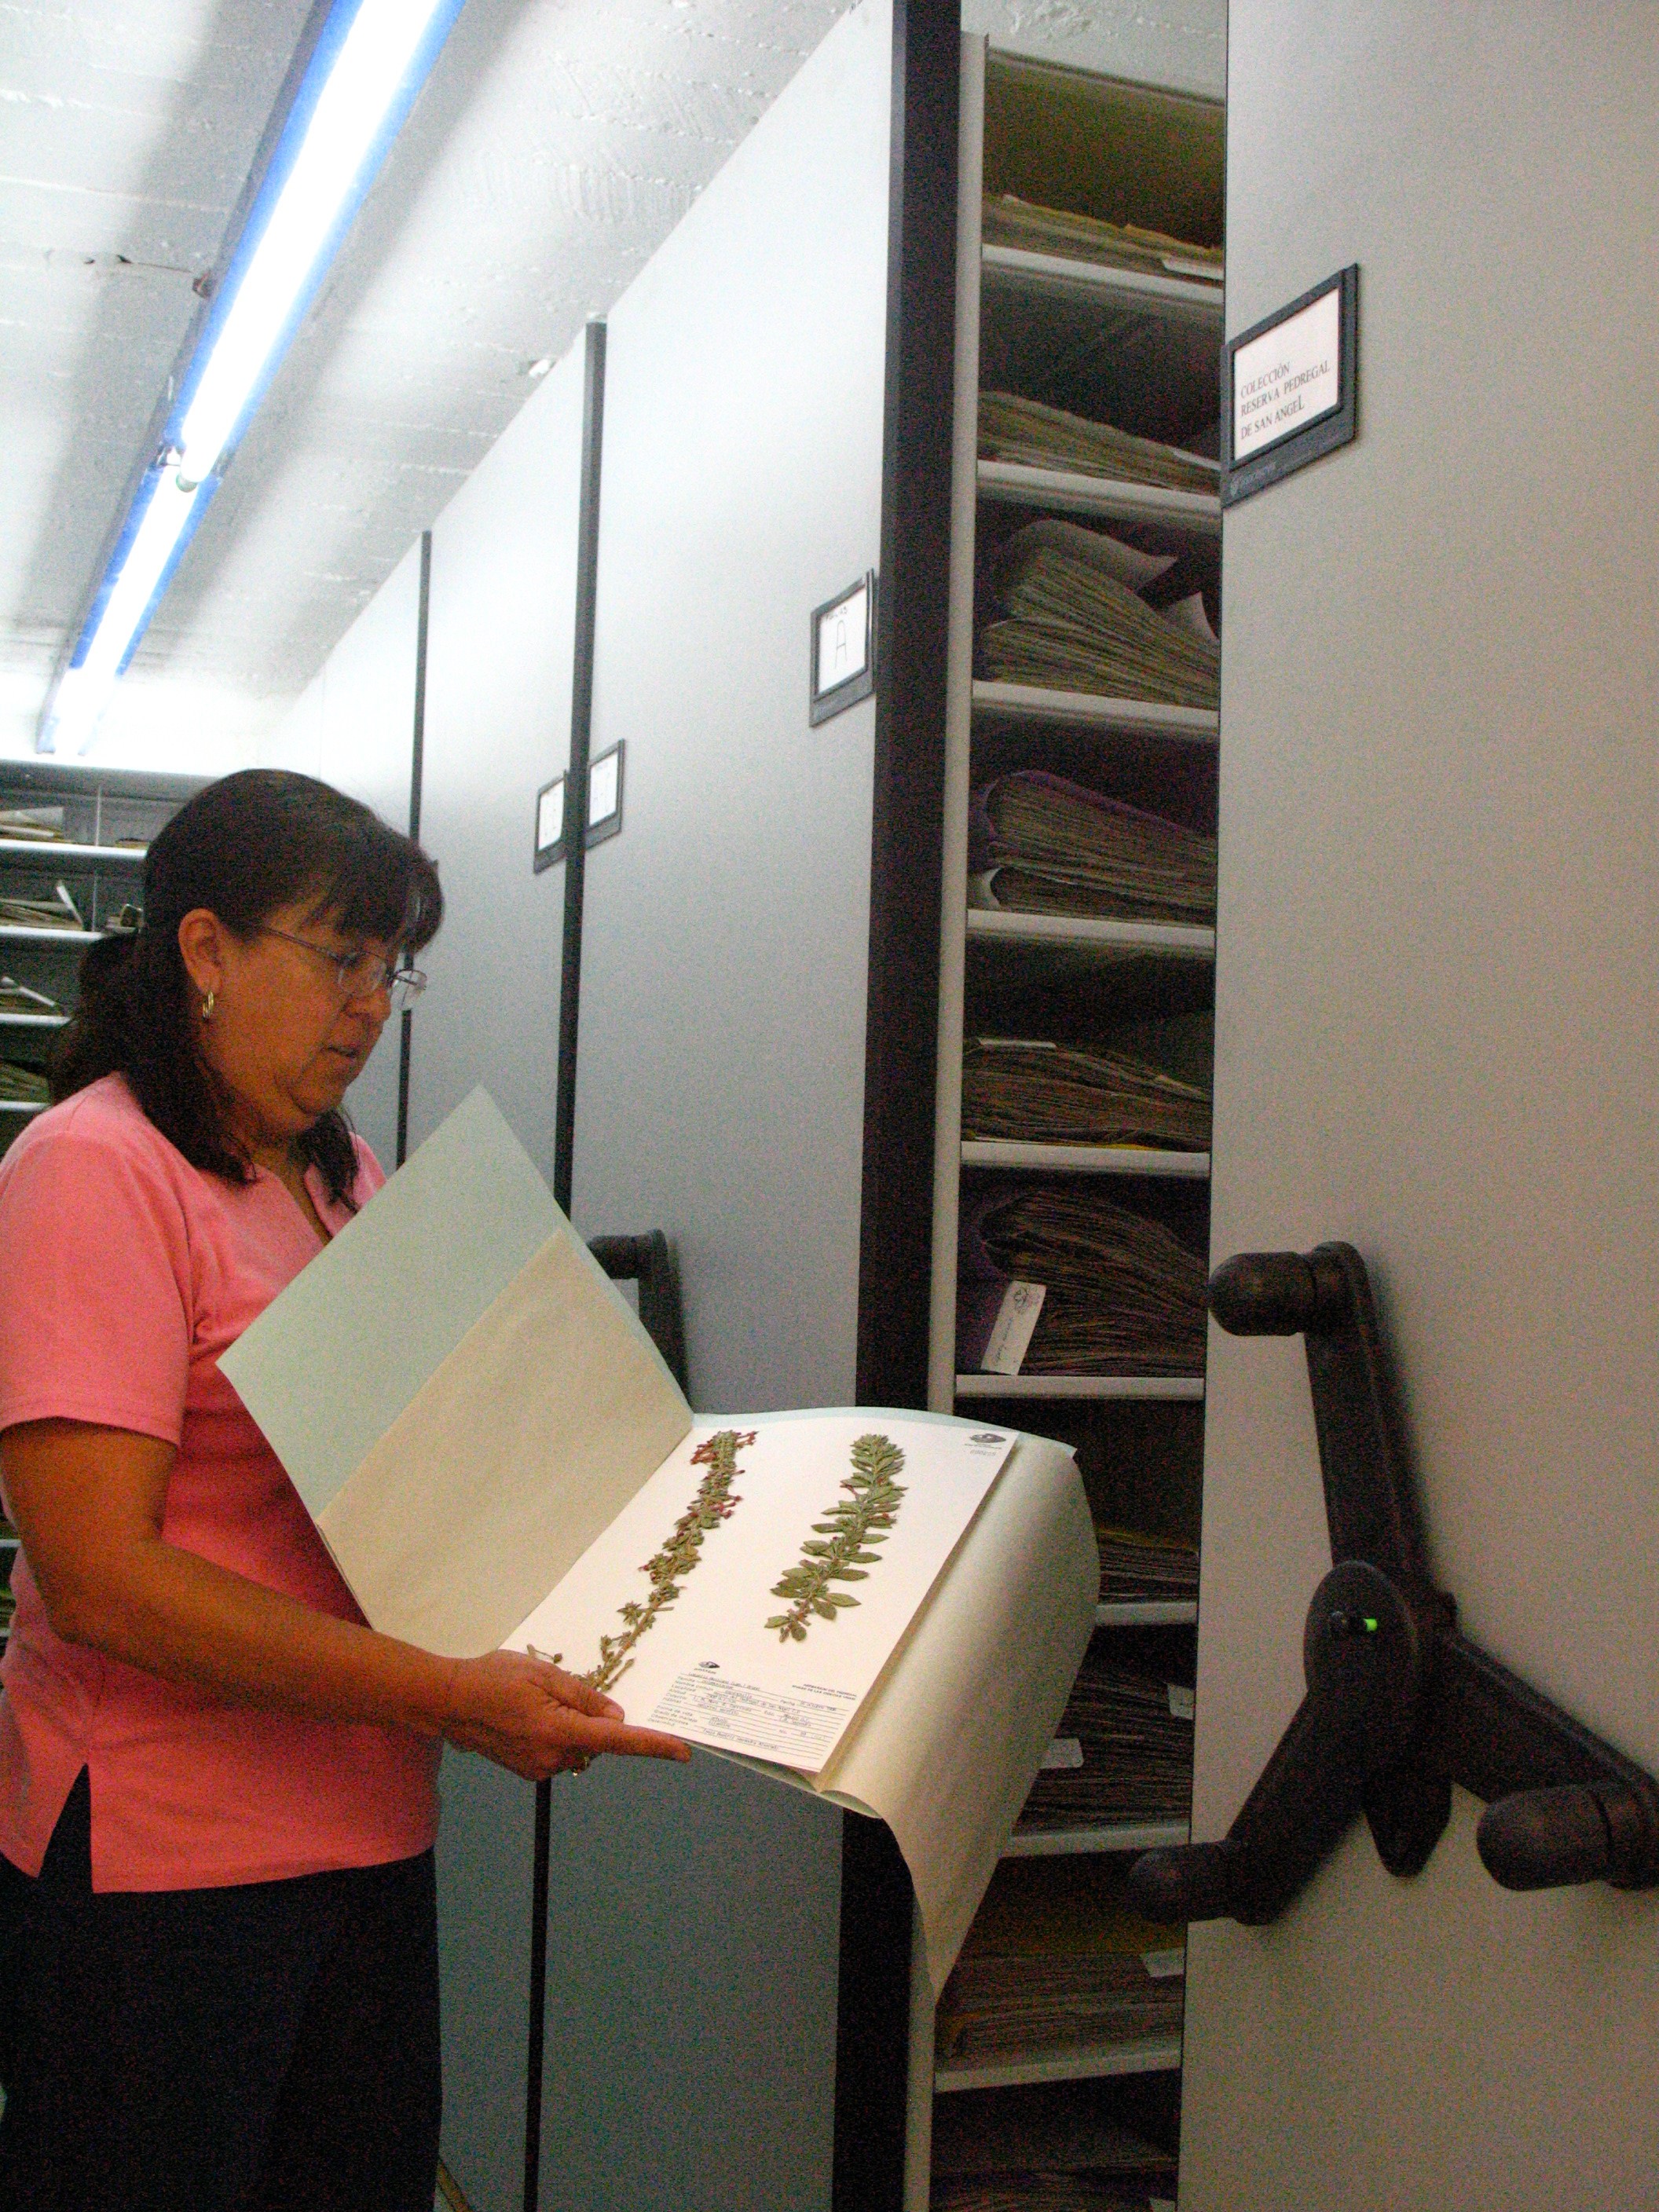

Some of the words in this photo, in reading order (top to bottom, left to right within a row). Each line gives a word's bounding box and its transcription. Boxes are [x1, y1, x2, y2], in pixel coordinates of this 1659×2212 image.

[1240, 362, 1291, 398] COLECCIÓN
[1240, 388, 1280, 417] RESERVA
[1283, 360, 1331, 396] PEDREGAL
[1240, 424, 1253, 440] DE
[1254, 412, 1273, 433] SAN
[1274, 394, 1306, 420] ANGEL
